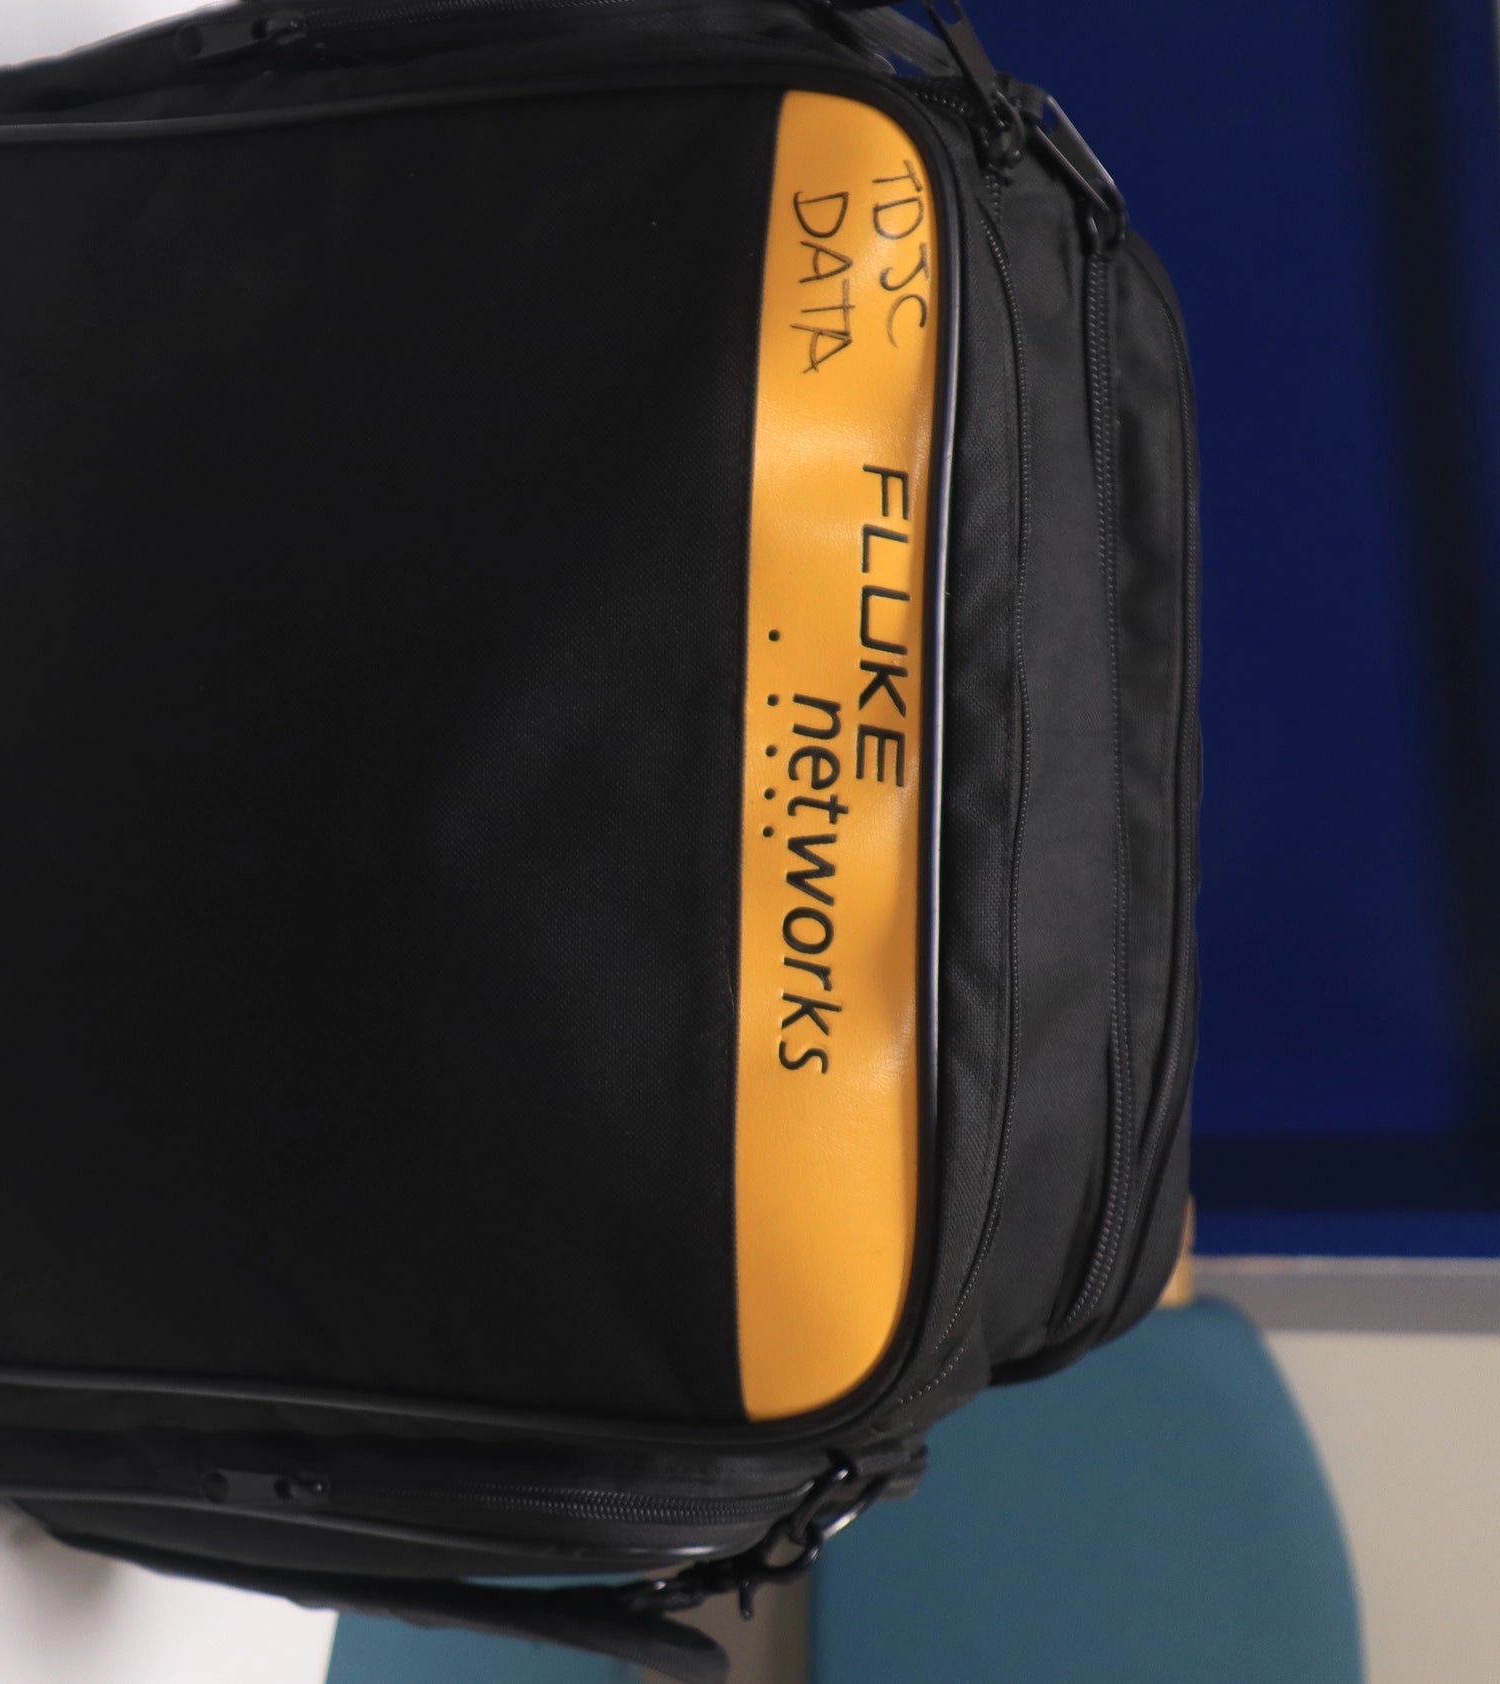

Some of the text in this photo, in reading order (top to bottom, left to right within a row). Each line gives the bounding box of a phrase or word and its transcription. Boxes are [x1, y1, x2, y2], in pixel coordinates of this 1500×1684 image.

[790, 190, 856, 374] DATA
[856, 463, 912, 788] FLUKE
[778, 692, 850, 1076] networks
